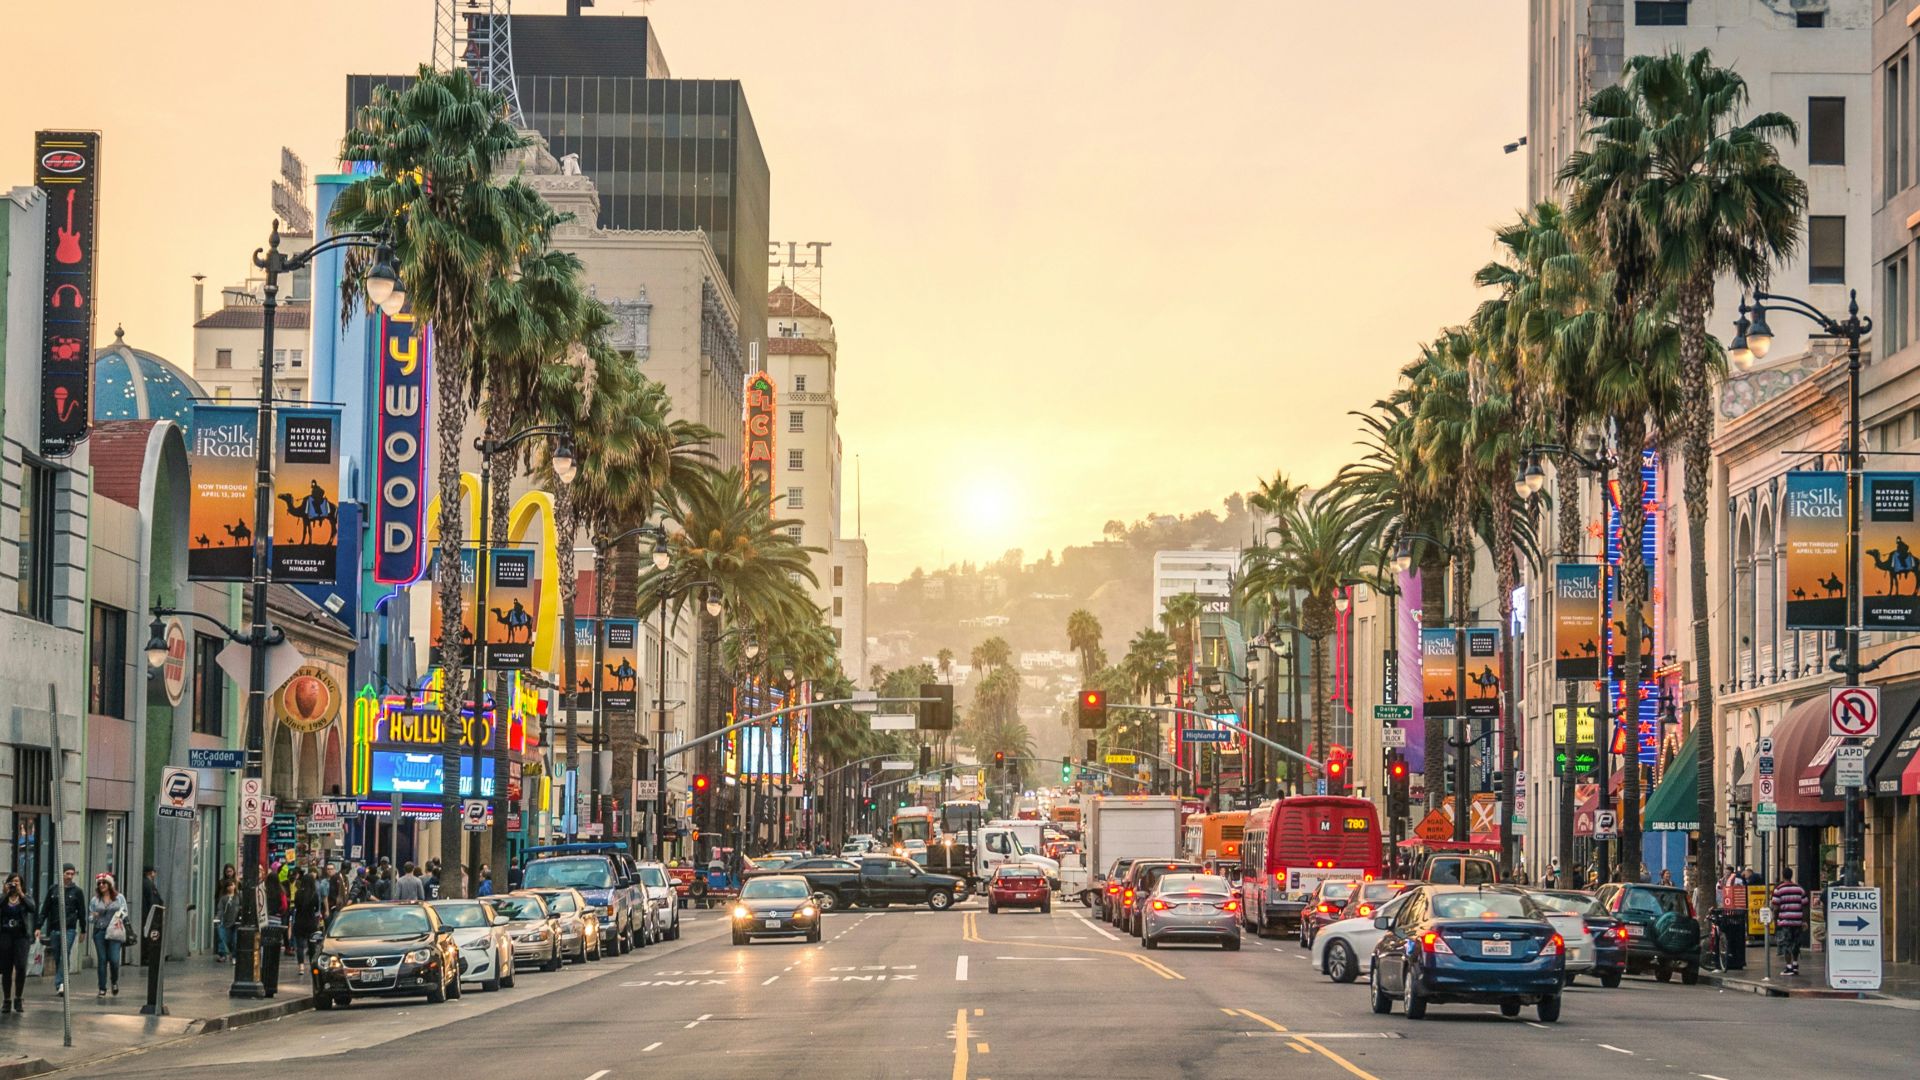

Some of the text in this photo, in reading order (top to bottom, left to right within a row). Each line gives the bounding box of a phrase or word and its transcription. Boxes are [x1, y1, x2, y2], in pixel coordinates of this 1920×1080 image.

[203, 424, 249, 444] The Silk
[203, 436, 253, 458] Road
[1797, 487, 1838, 505] The Silk
[1796, 498, 1842, 518] Road
[1572, 576, 1593, 589] Silk
[1563, 585, 1597, 599] Road
[1434, 637, 1451, 648] Silk
[1427, 644, 1455, 656] Road
[315, 669, 336, 693] KING
[285, 716, 327, 731] Since 1989
[1186, 732, 1216, 740] Highland
[190, 749, 234, 761] McCadden
[1837, 748, 1863, 757] LAPD
[160, 808, 192, 818] PAY HERE
[314, 804, 336, 815] ATM
[308, 820, 341, 828] INTERNET
[1347, 818, 1365, 829] 780
[1652, 821, 1676, 830] CAMERAS
[1830, 891, 1877, 900] PUBLIC
[1830, 901, 1877, 910] PARKING
[1834, 938, 1846, 946] PARK
[1862, 939, 1875, 947] WALK
